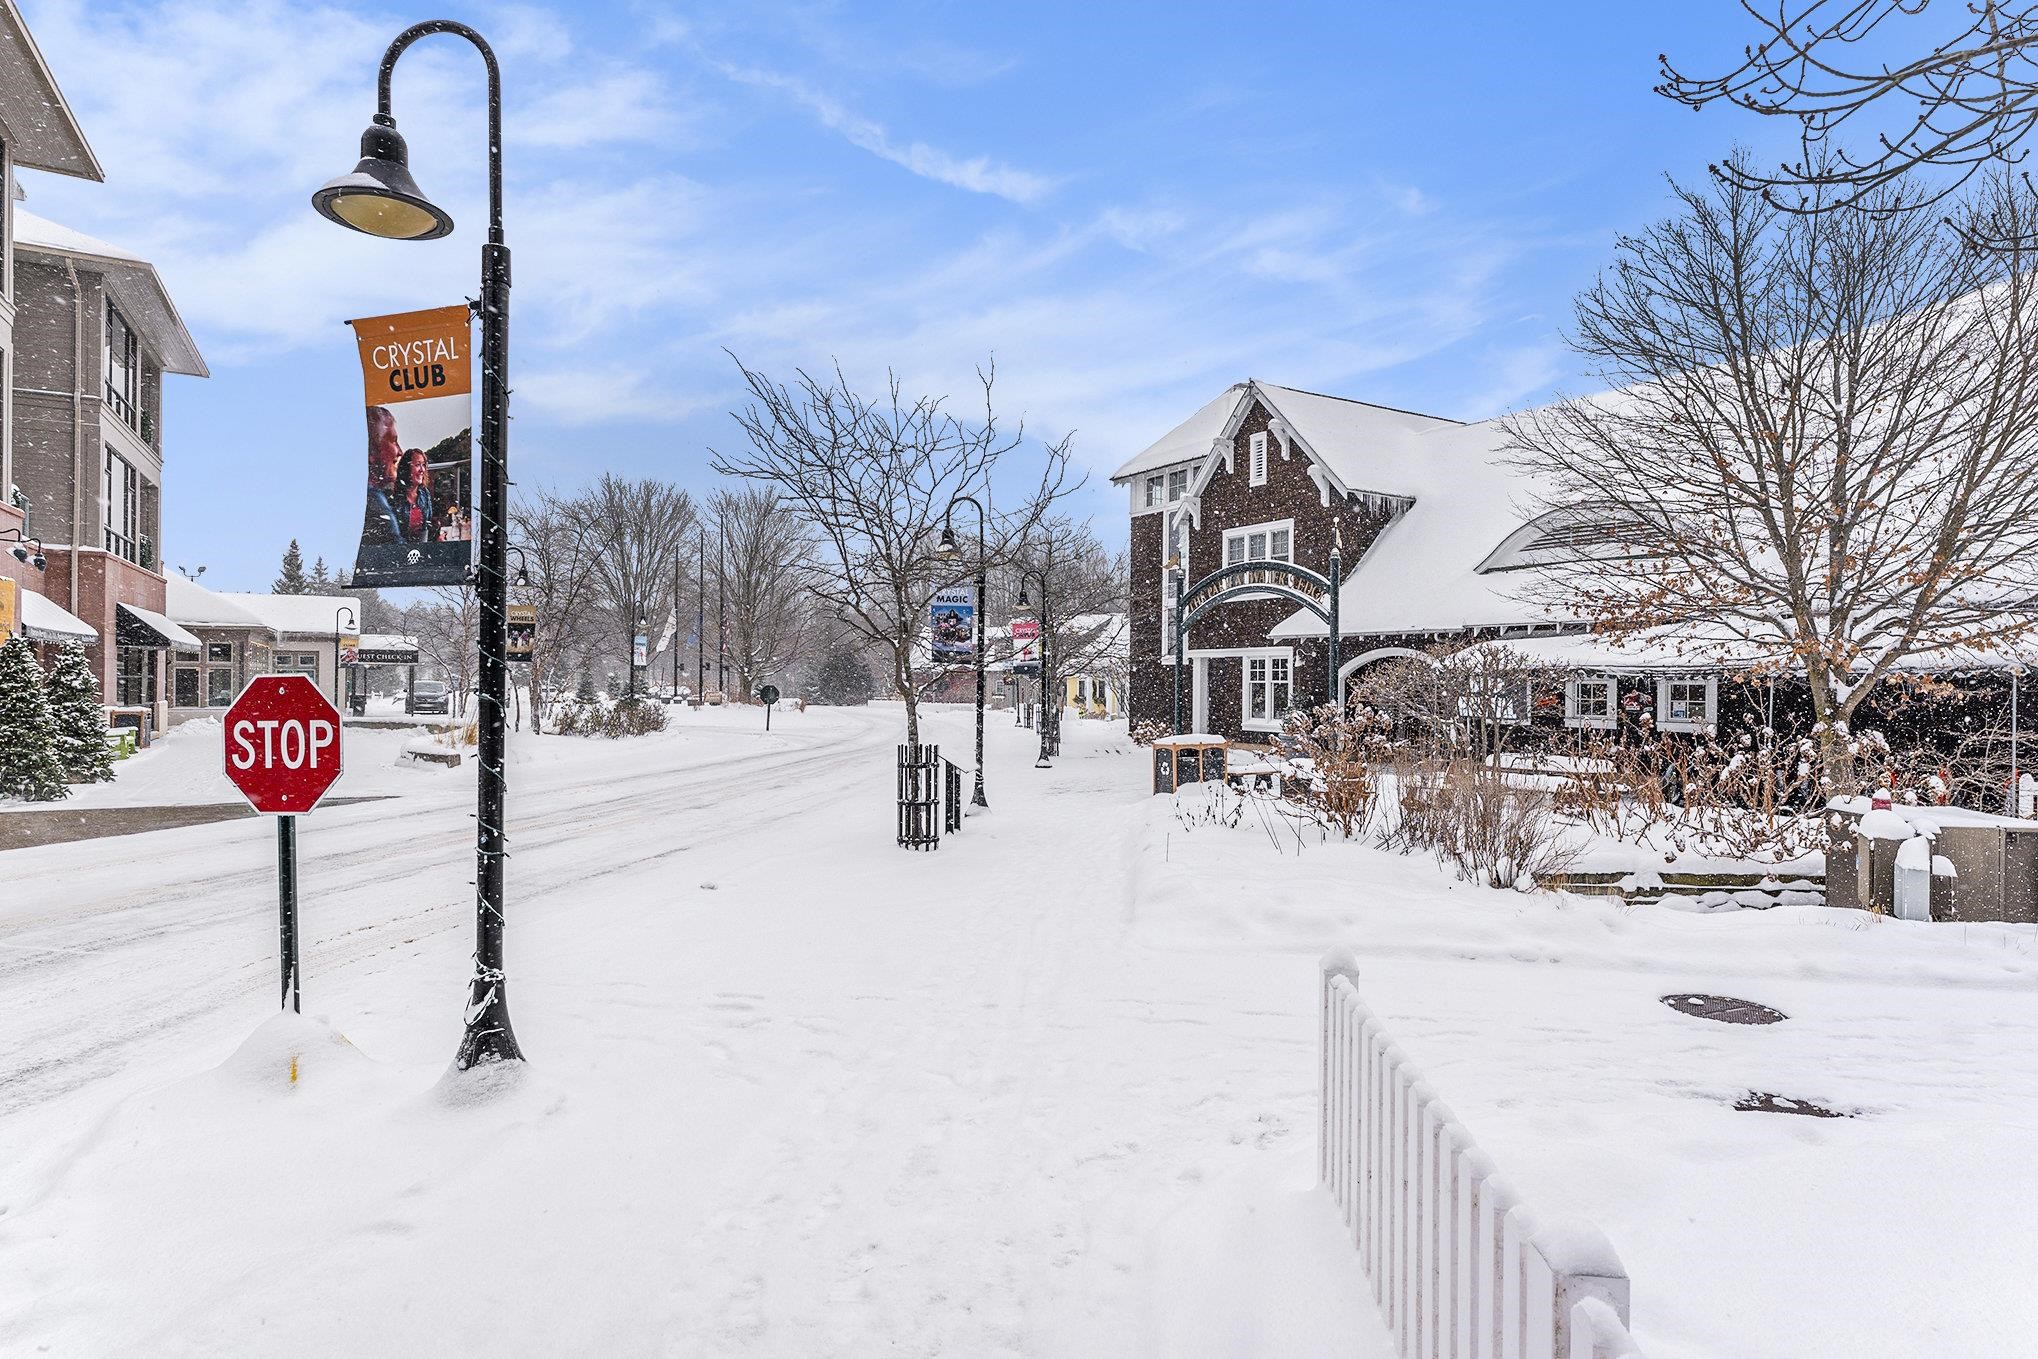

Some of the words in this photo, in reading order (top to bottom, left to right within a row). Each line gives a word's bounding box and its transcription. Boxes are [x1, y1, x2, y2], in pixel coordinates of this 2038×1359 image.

[373, 336, 459, 370] CRYSTAL
[389, 363, 446, 392] CLUB
[936, 595, 968, 603] MAGIC
[231, 719, 334, 770] STOP
